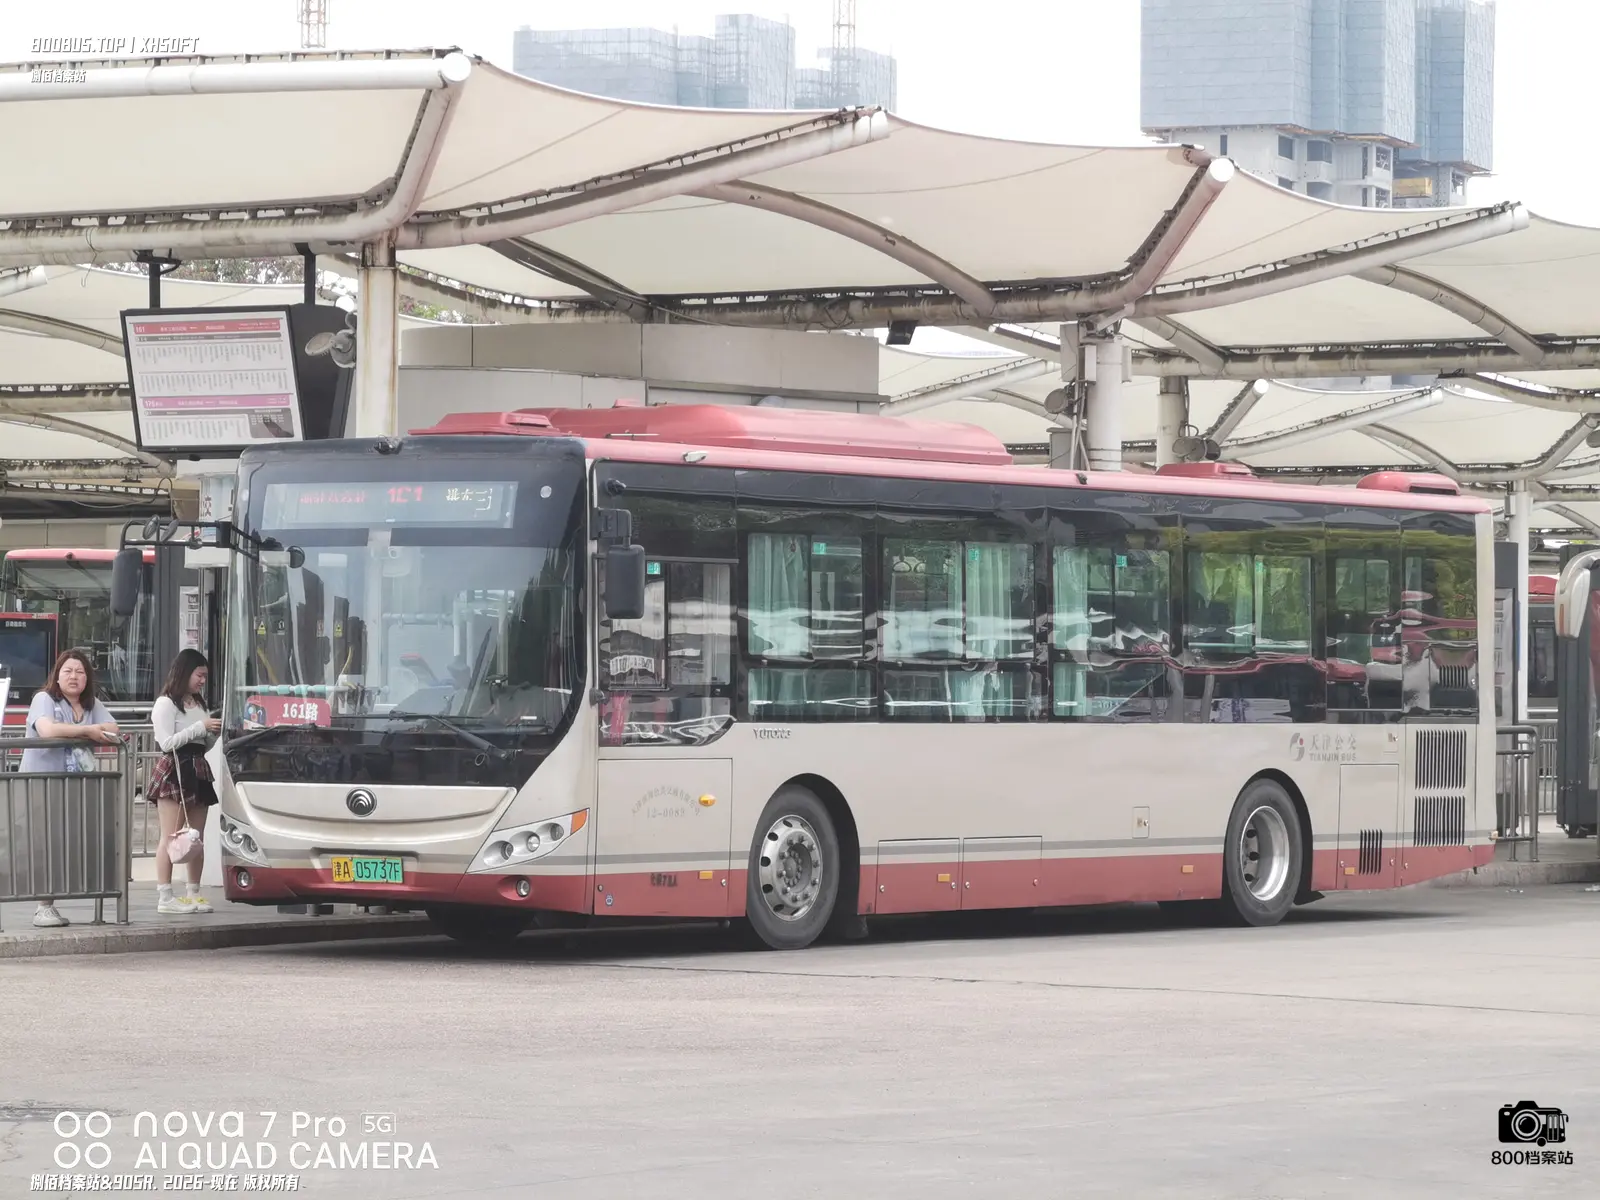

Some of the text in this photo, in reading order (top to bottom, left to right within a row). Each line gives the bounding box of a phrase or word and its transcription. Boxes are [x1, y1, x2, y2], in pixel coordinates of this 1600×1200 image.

[282, 702, 318, 721] 161路
[1309, 733, 1357, 750] 天津公交
[1309, 752, 1357, 762] TIANJIN BUS
